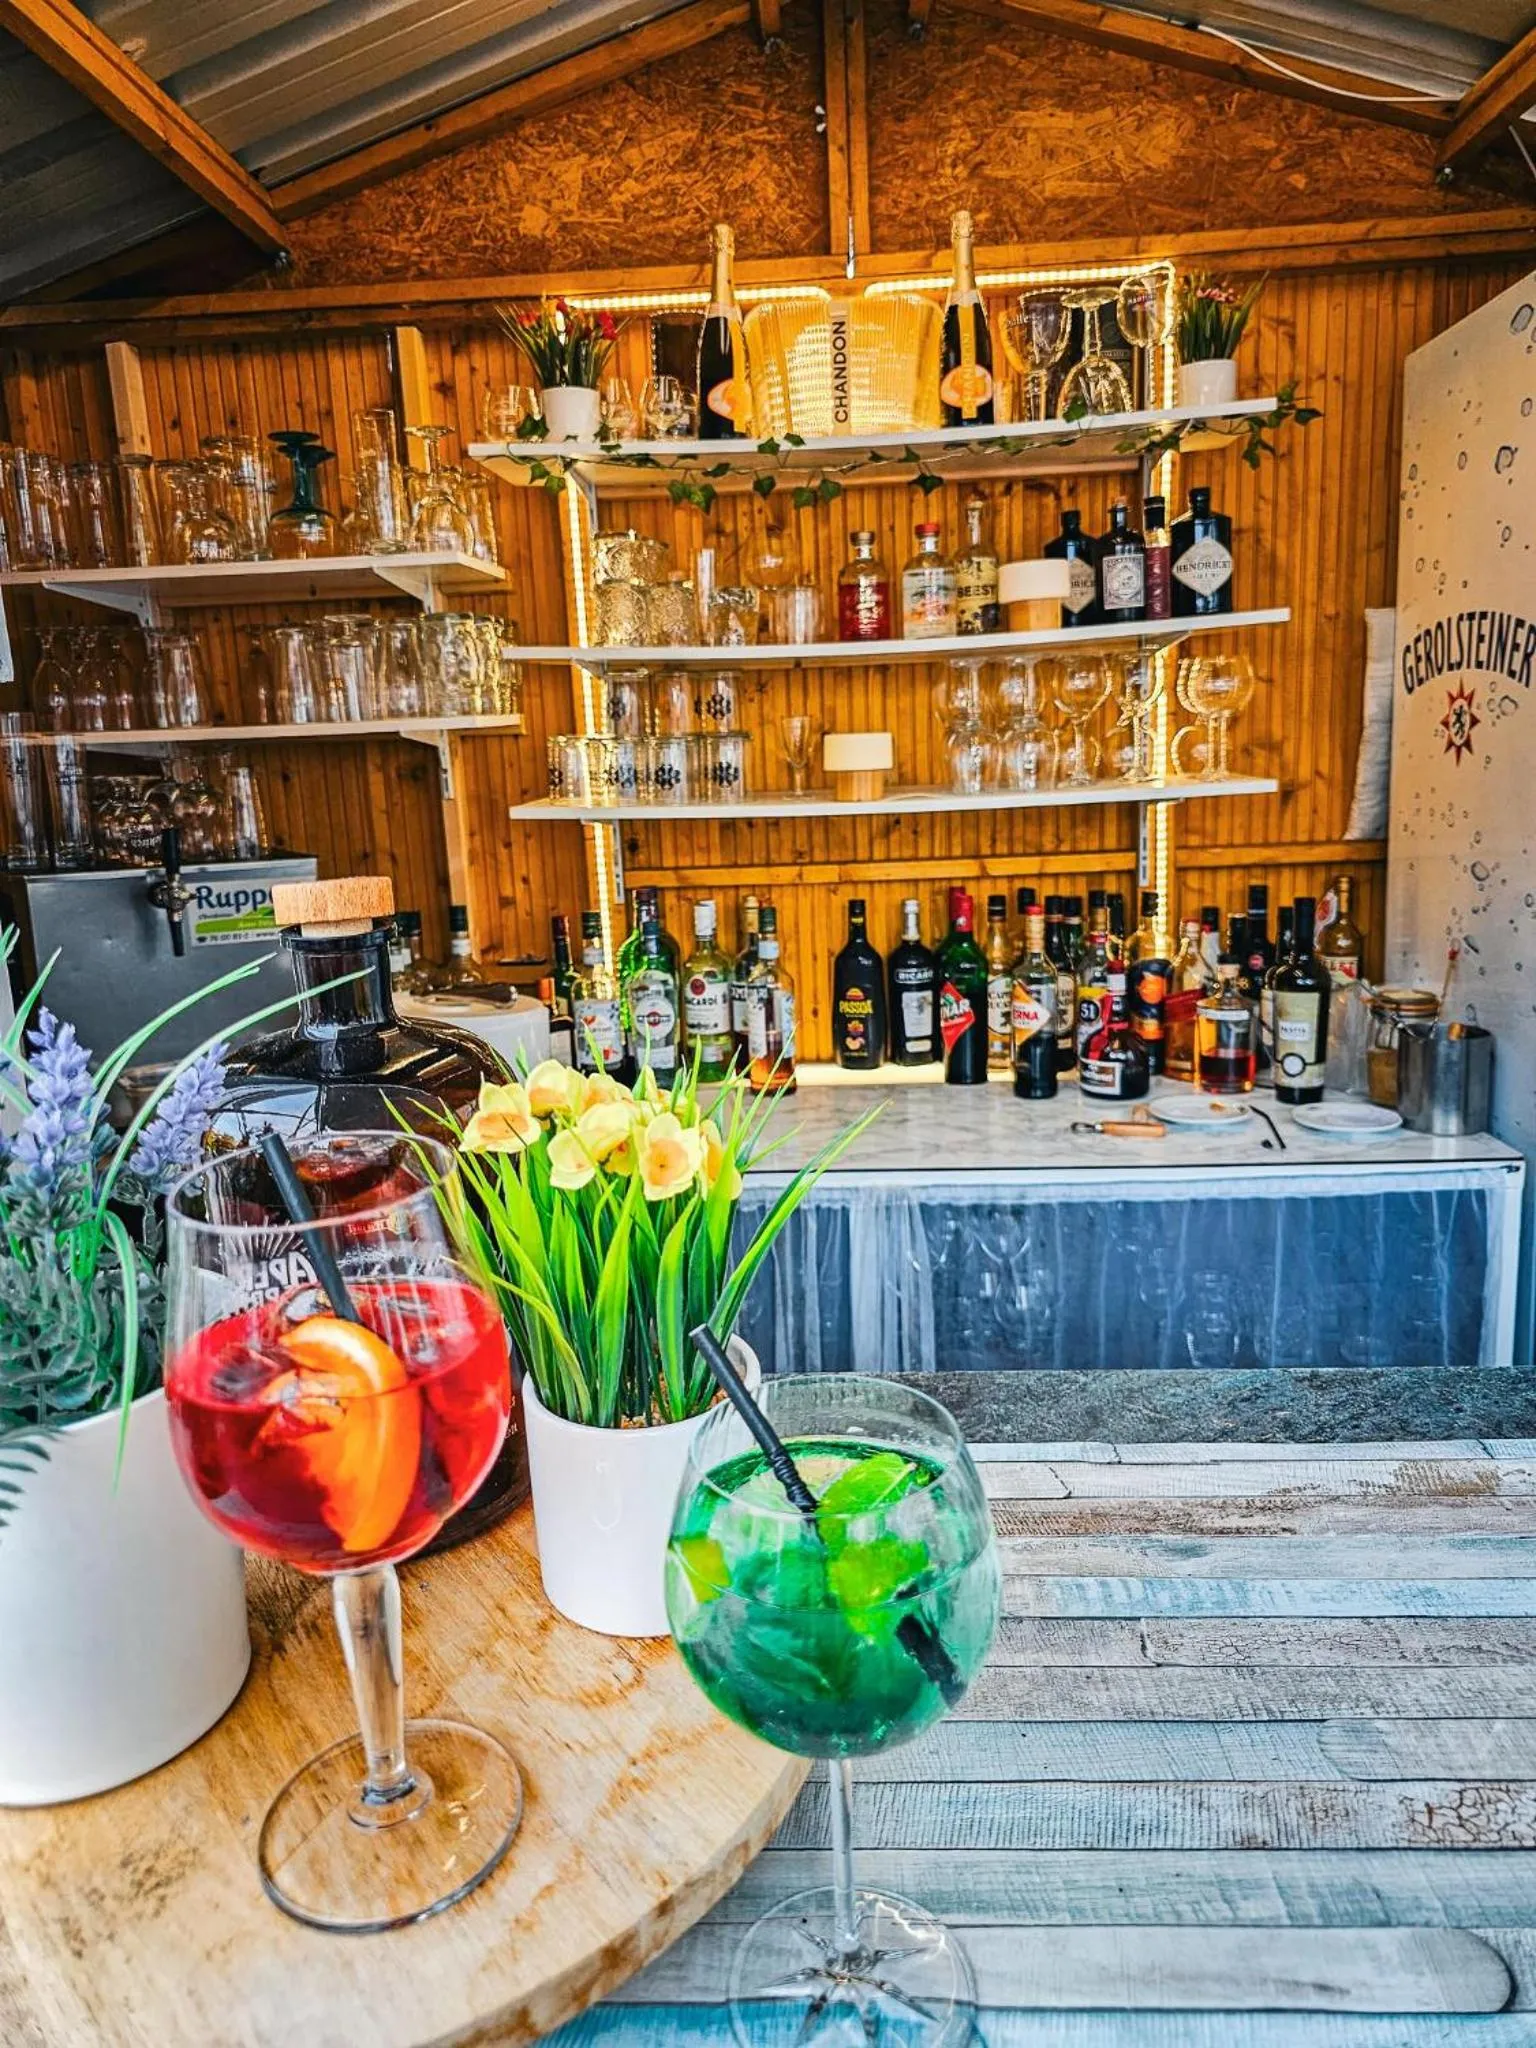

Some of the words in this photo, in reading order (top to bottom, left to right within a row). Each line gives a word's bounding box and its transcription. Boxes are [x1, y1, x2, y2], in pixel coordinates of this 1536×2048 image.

[832, 319, 849, 424] CHANDON
[1402, 610, 1536, 695] GEROLSTEINER
[195, 885, 273, 912] Rupp
